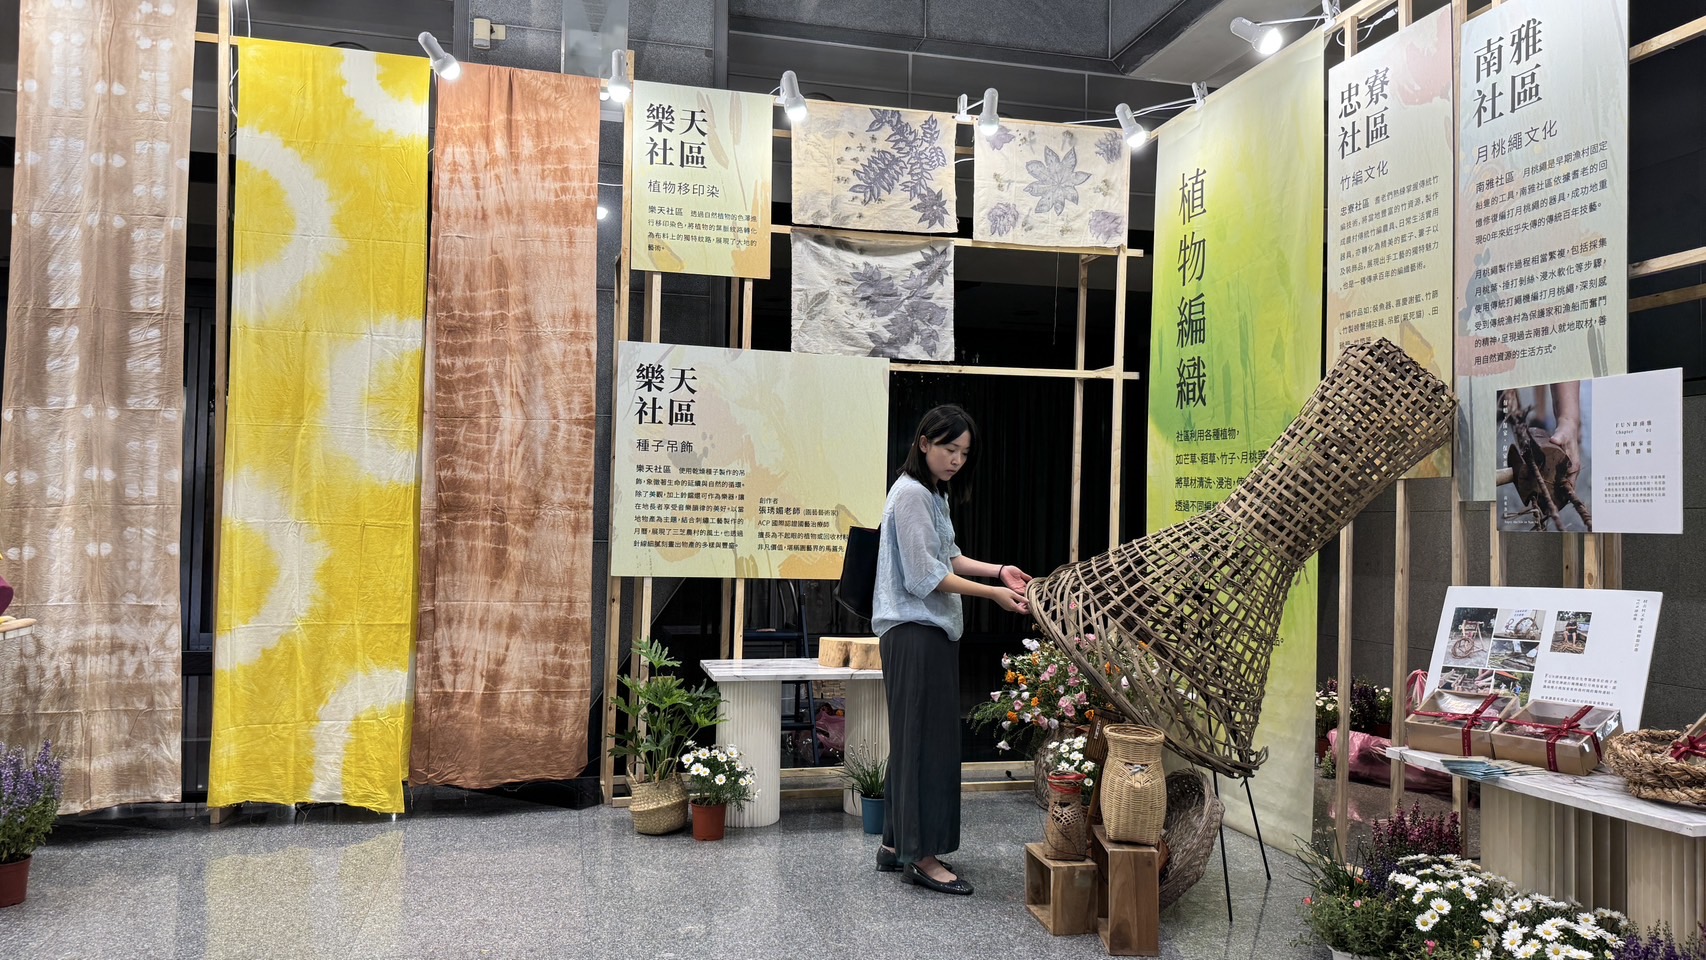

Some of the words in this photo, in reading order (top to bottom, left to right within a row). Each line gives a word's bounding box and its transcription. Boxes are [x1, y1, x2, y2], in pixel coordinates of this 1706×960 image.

[1473, 17, 1543, 84] 南雅
[1338, 67, 1390, 119] 忠寮
[1472, 63, 1543, 128] 社區
[645, 103, 708, 137] 樂天
[1337, 106, 1390, 160] 社區
[645, 136, 708, 169] 社區
[1475, 119, 1558, 165] 月桃繩文化
[648, 179, 720, 198] 植物移印染
[1339, 160, 1389, 192] 竹編文化
[1475, 170, 1514, 194] 南雅社區
[648, 205, 683, 216] 樂天社區
[1340, 197, 1370, 217] 忠寮社區
[648, 243, 665, 251] 藝術。
[1176, 168, 1207, 410] 植物編織
[635, 363, 697, 394] 樂天
[634, 395, 696, 426] 社區
[636, 438, 693, 453] 種子吊飾
[1176, 427, 1240, 442] 社區利用各種植物，
[636, 464, 671, 474] 樂天社區
